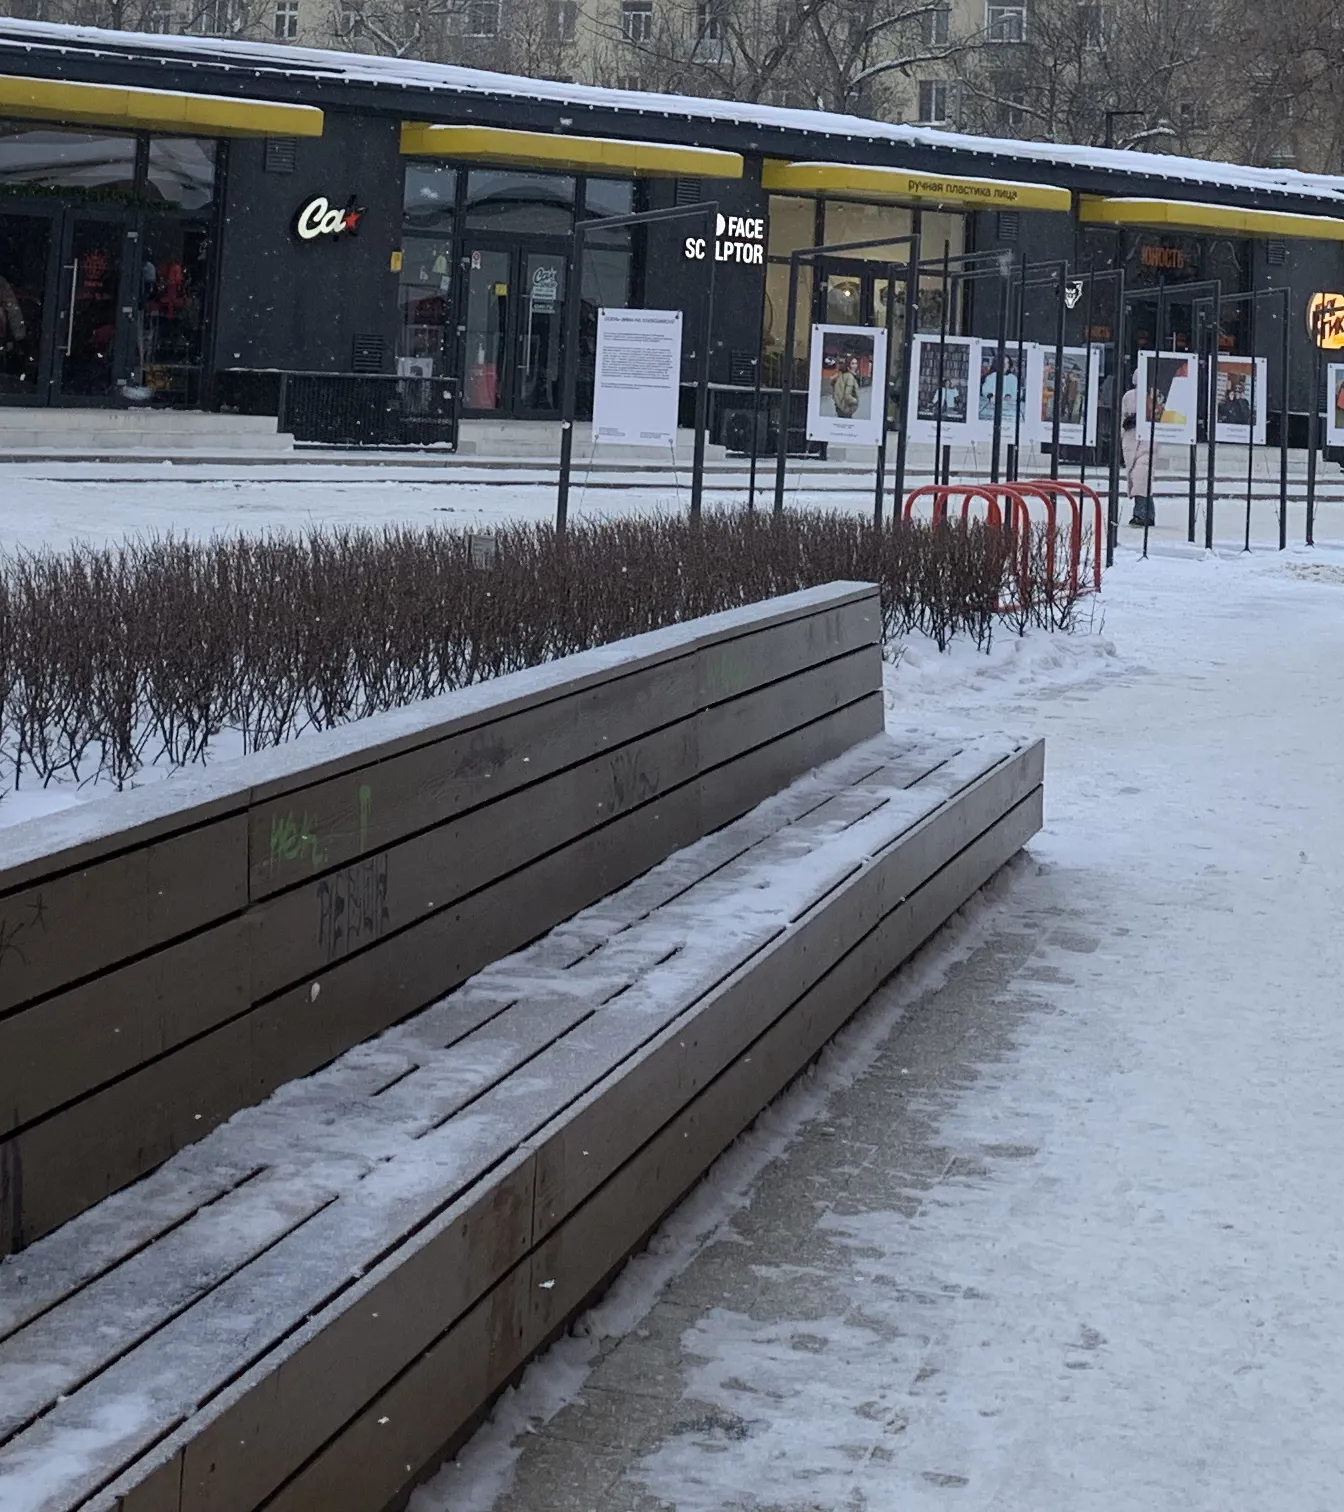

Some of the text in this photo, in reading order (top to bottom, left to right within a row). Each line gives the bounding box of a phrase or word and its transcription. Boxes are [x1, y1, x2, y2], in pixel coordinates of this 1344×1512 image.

[908, 179, 1018, 201] ручная пластика лица
[728, 216, 764, 239] FACE
[685, 237, 763, 264] SCLPTOR
[1141, 245, 1185, 270] ЮНОСТЬ
